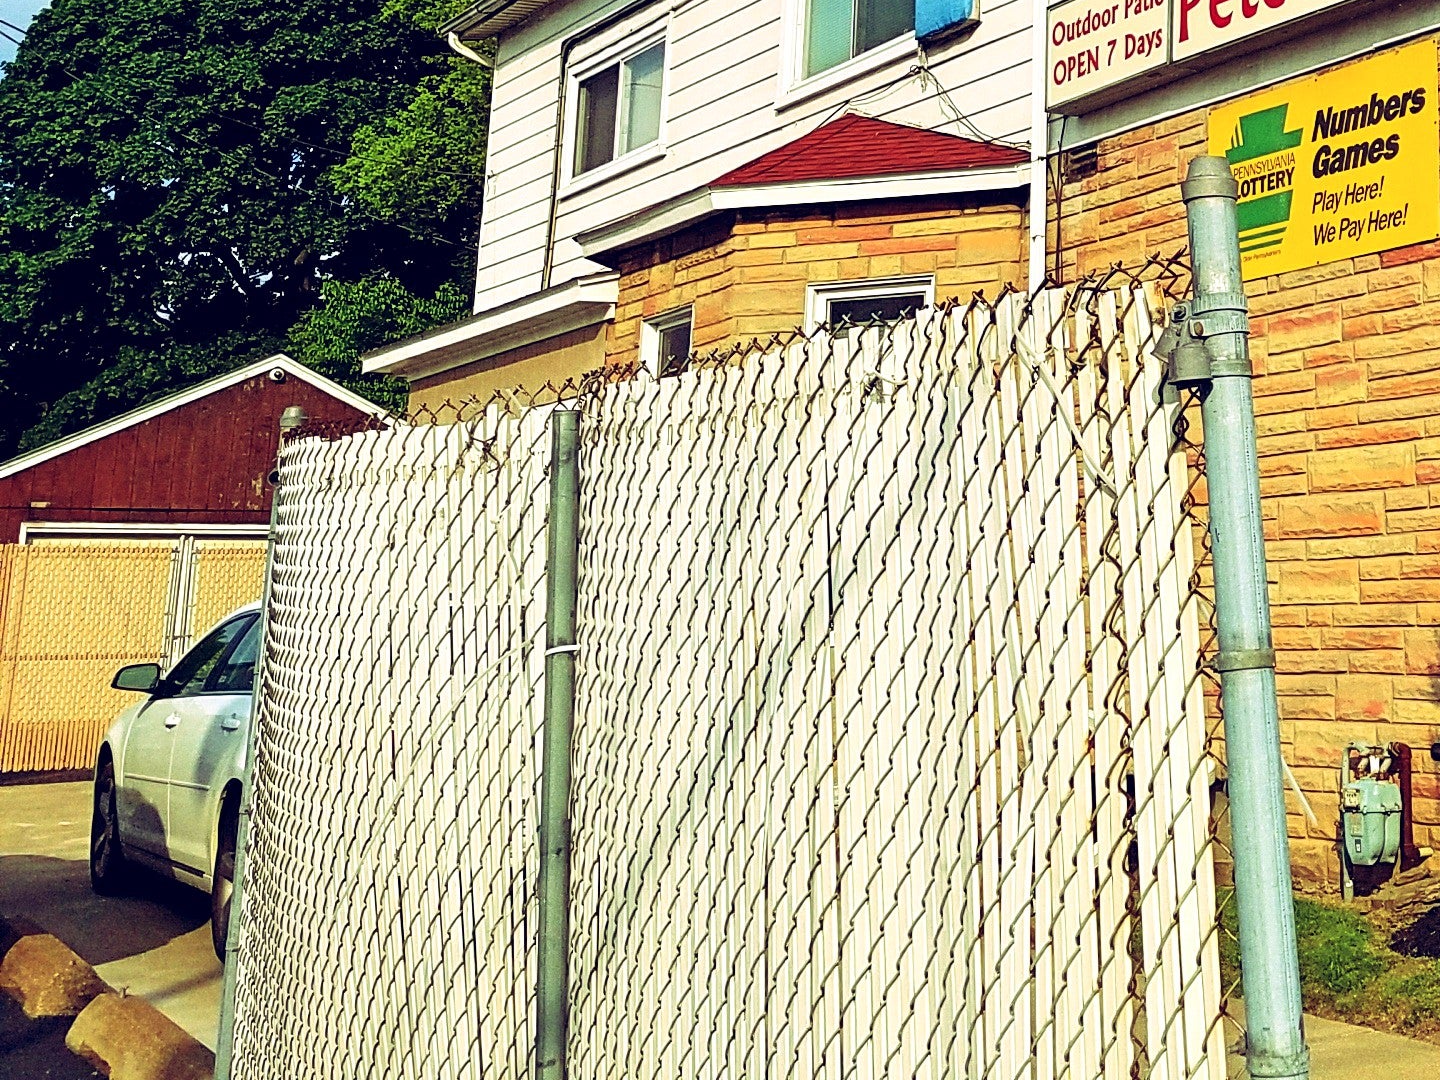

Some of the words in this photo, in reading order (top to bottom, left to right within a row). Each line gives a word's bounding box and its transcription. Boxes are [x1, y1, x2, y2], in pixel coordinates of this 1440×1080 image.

[1052, 9, 1119, 46] Outdoor
[1053, 45, 1099, 85] OPEN
[1107, 39, 1117, 67] 7
[1124, 28, 1162, 60] Days
[1312, 87, 1426, 142] Numbers
[1233, 152, 1296, 179] PENNSYLVANIA
[1312, 133, 1400, 179] Games
[1312, 189, 1343, 214] Play
[1344, 176, 1384, 207] Here!
[1313, 222, 1336, 246] We
[1339, 217, 1366, 241] Pay
[1367, 203, 1409, 233] Here!
